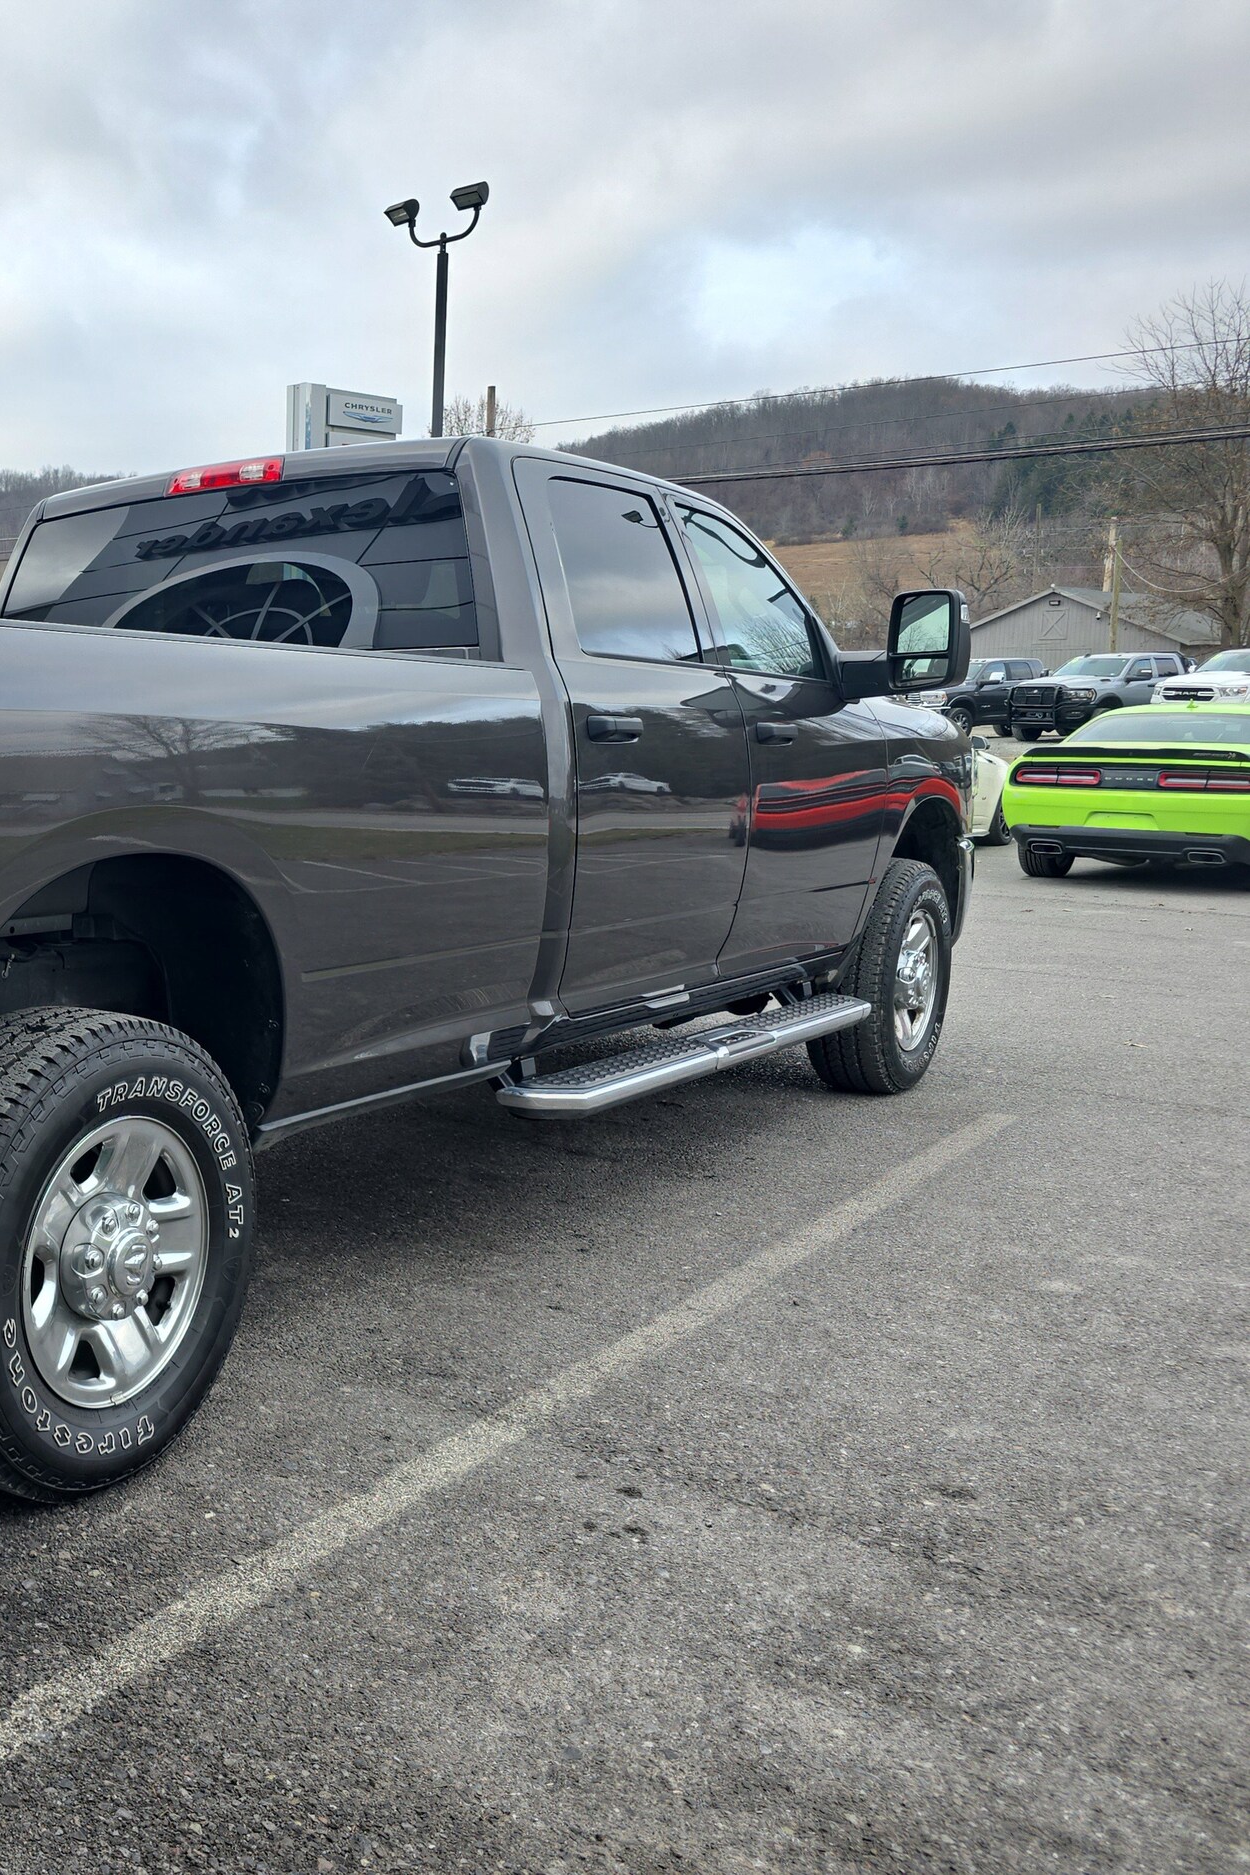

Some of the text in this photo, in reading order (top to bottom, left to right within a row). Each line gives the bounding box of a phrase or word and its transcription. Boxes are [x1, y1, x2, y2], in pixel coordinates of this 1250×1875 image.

[344, 402, 393, 415] CHRYSLER
[97, 1076, 237, 1171] TRANSFORCE
[3, 1318, 155, 1455] Firestone
